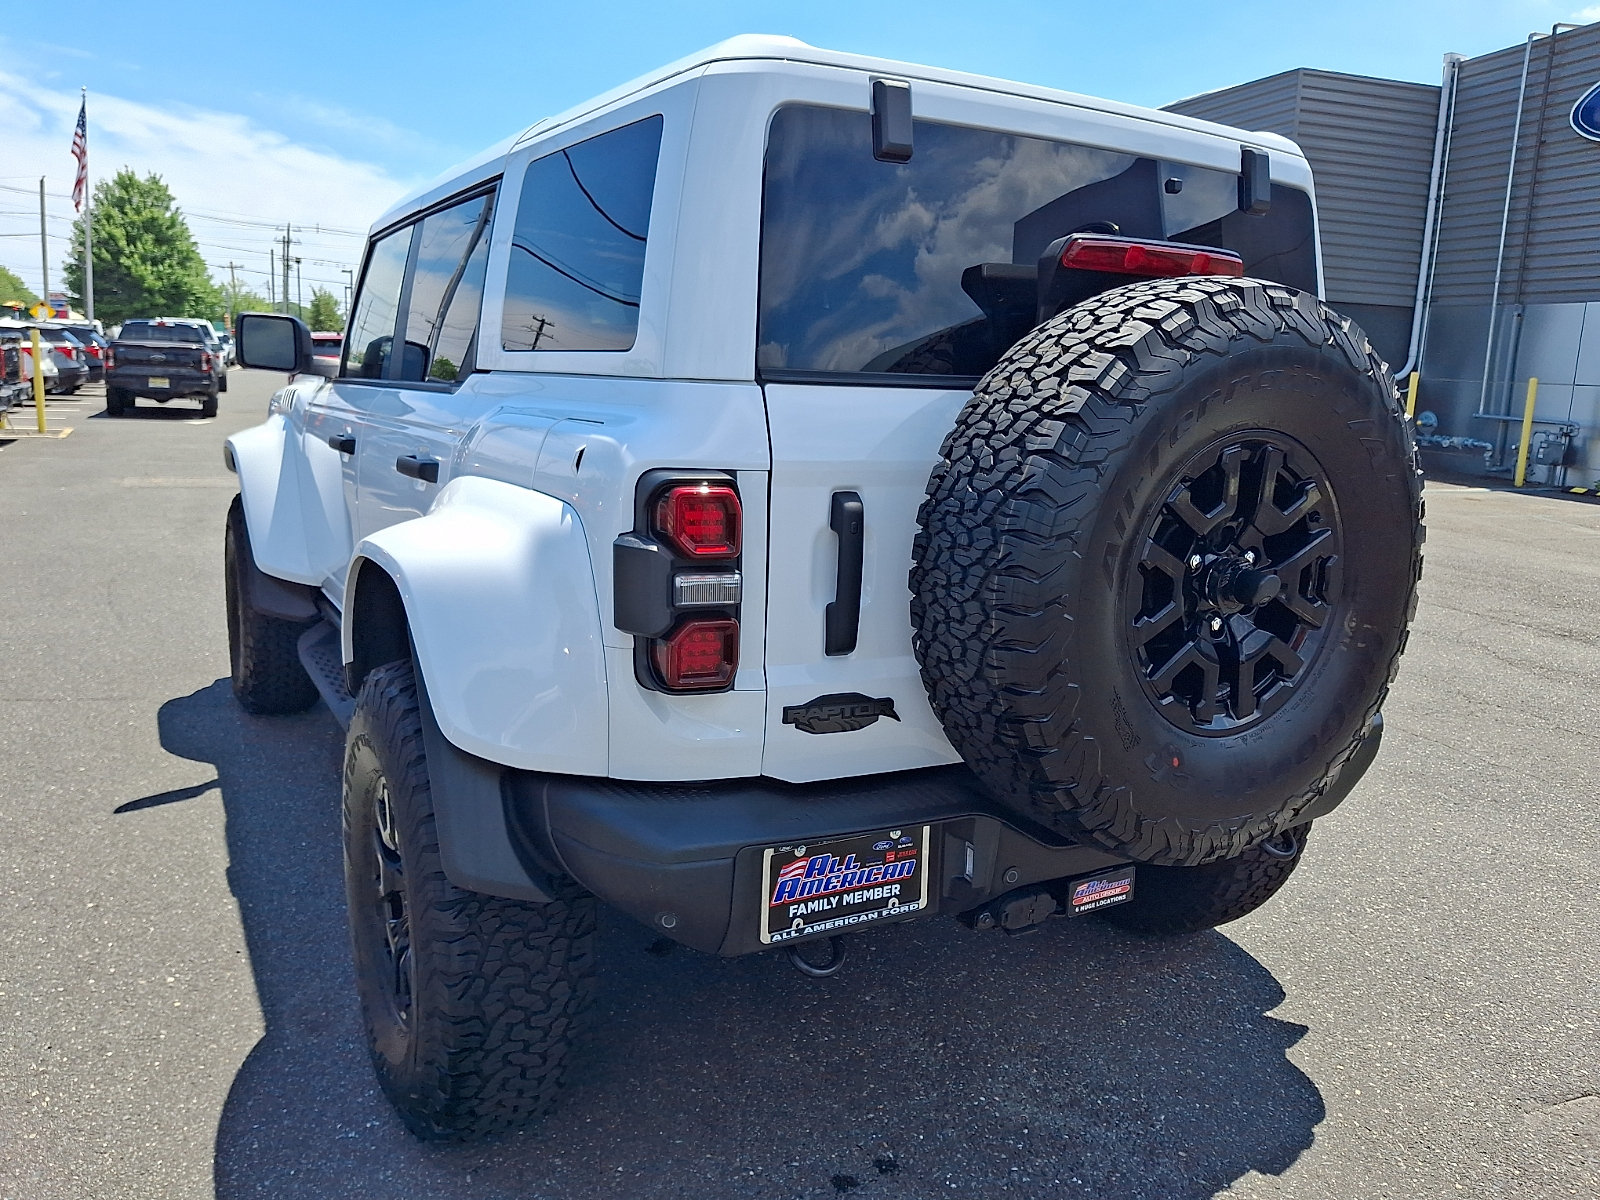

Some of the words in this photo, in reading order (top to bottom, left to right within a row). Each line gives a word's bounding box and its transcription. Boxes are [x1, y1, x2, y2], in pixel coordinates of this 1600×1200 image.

[786, 699, 897, 726] RAPTOR
[789, 895, 839, 917] FAMILY
[842, 884, 900, 906] MEMBER
[1080, 903, 1095, 911] HUGE
[1096, 894, 1126, 906] LOCATIONS
[1083, 892, 1099, 903] AUTO
[1100, 887, 1122, 898] GROUP
[772, 931, 799, 942] ALL
[804, 912, 878, 934] AMERICAN
[882, 904, 918, 916] FORD
